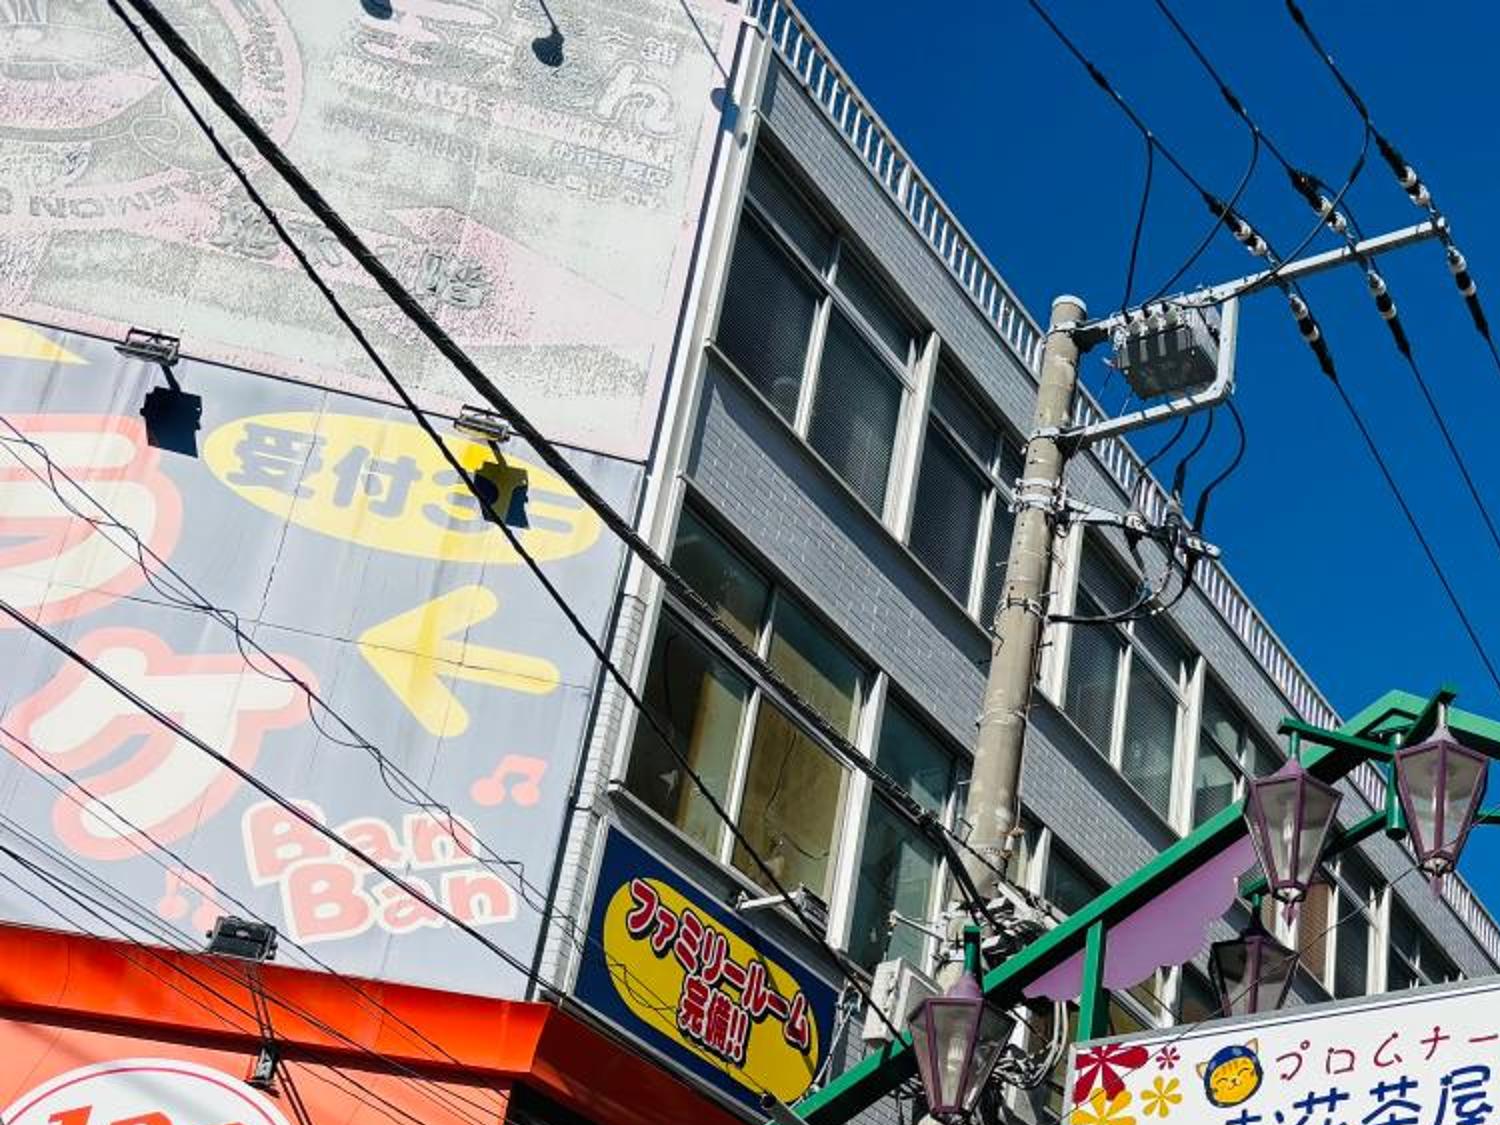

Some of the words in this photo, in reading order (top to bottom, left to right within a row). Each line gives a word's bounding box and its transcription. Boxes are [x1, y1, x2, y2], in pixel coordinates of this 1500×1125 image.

[244, 800, 484, 885] Ban
[285, 860, 517, 941] Ban
[627, 878, 811, 1047] ファミリールーム
